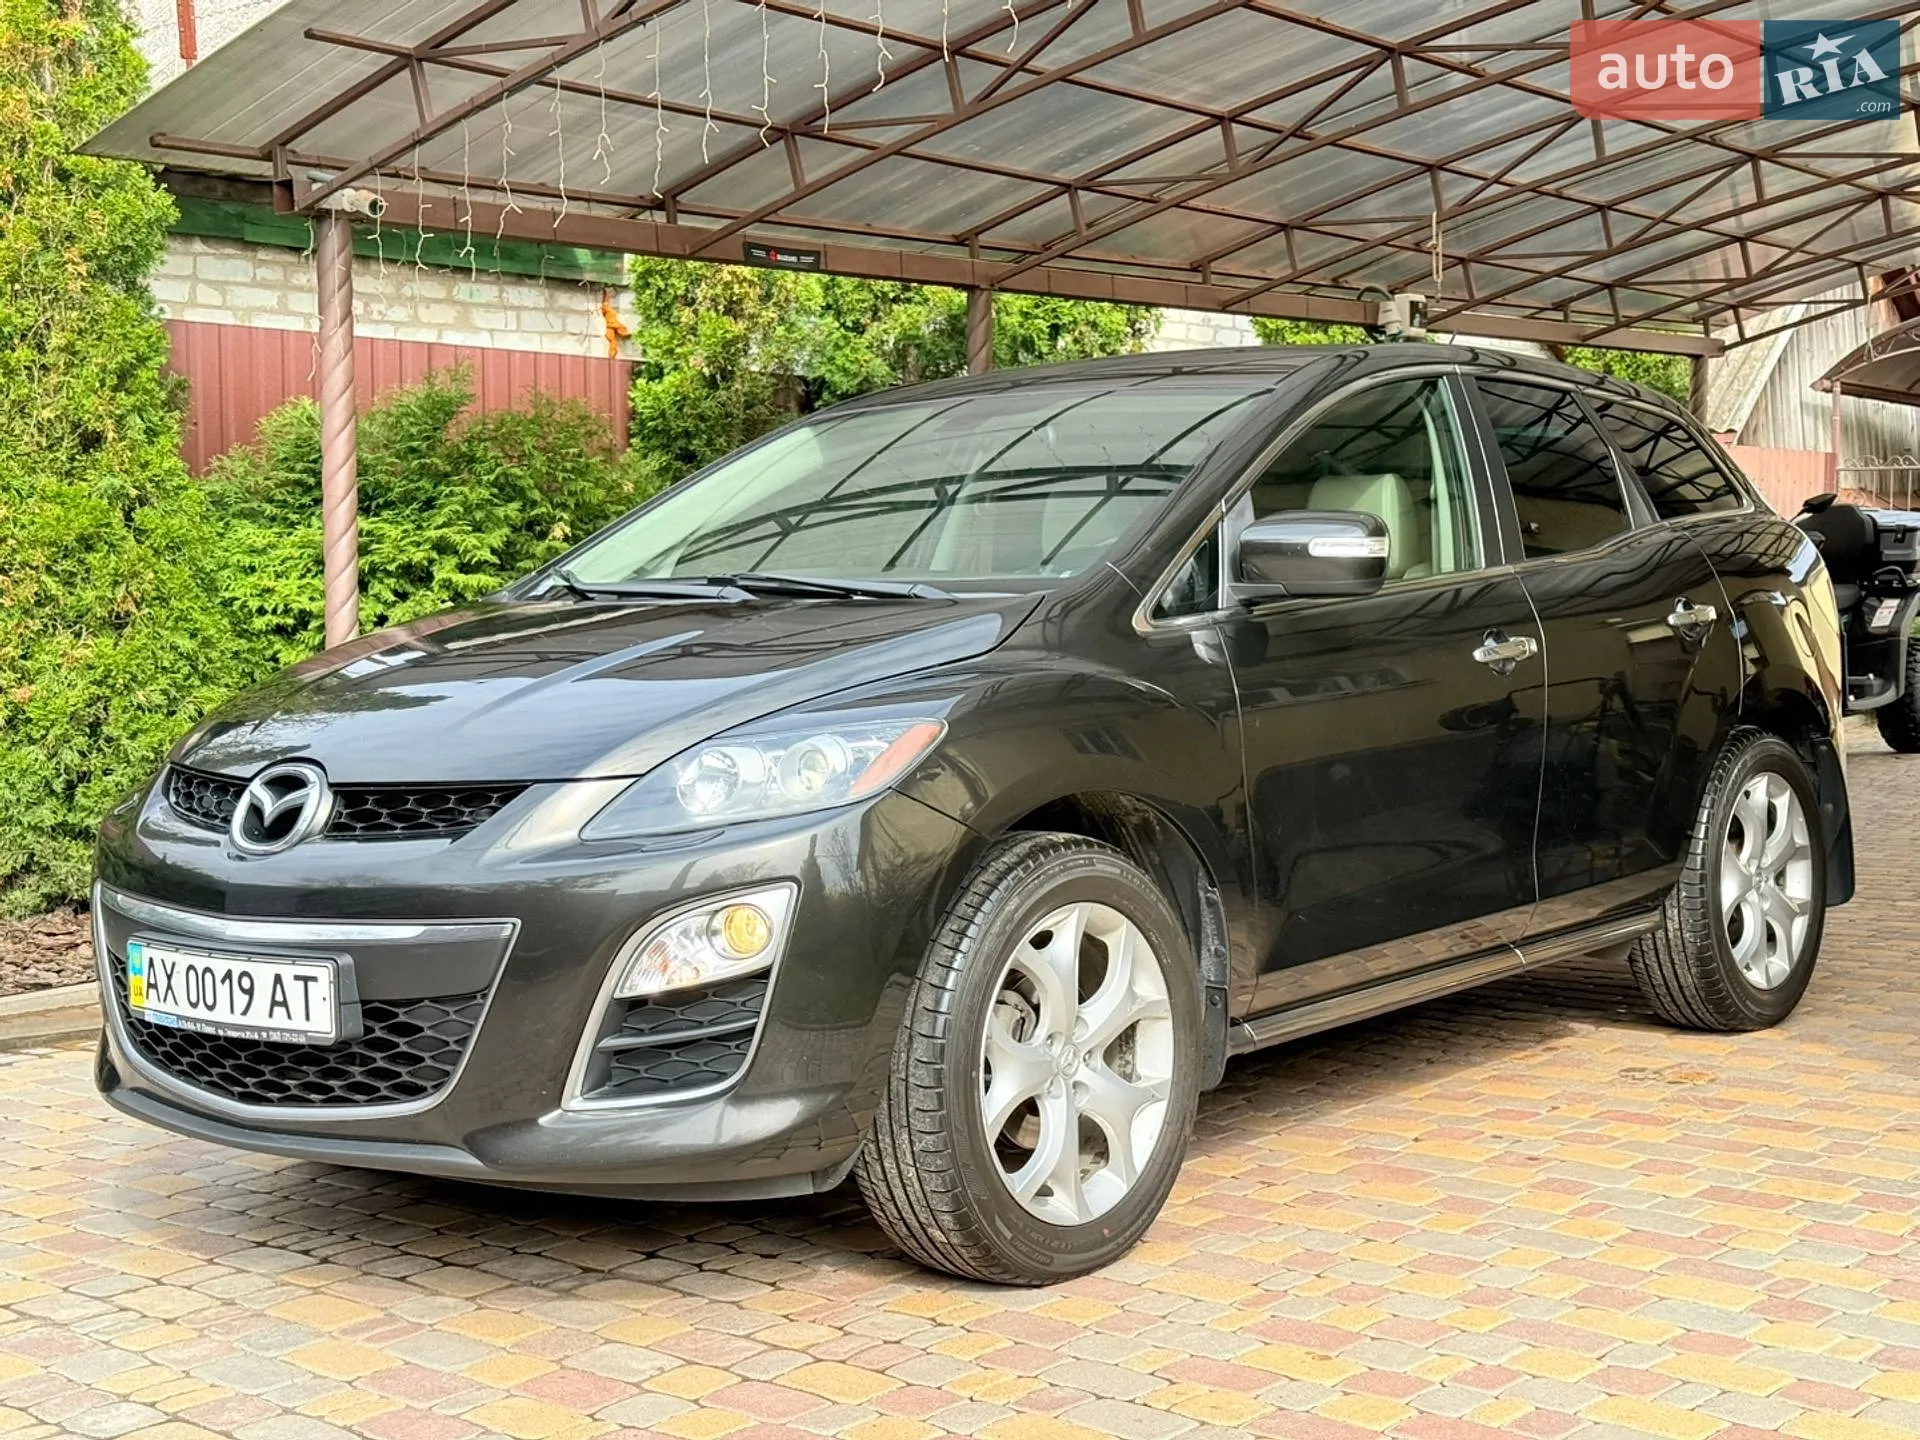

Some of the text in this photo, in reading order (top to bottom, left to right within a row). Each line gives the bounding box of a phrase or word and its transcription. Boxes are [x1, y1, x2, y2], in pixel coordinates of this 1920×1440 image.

[145, 957, 318, 1022] AX 0019 AT
